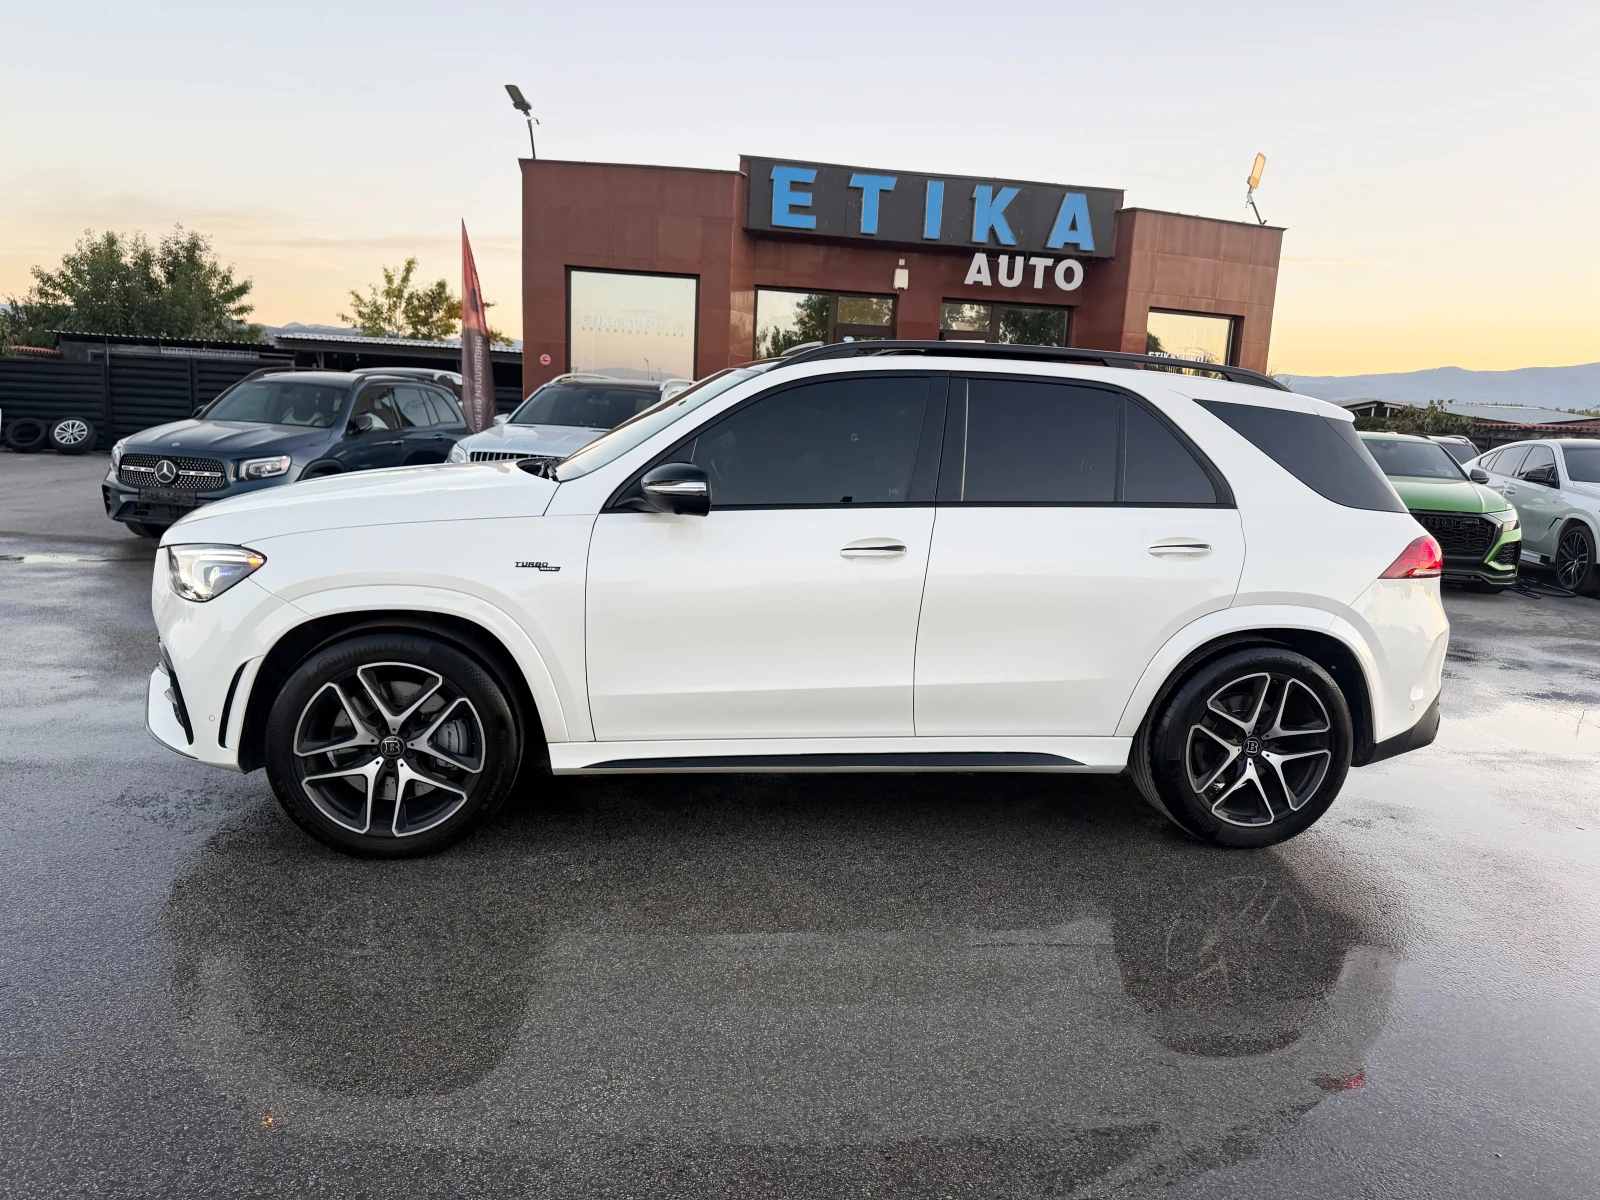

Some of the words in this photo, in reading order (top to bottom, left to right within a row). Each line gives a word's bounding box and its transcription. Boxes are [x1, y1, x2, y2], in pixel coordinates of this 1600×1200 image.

[770, 165, 1095, 251] ETIKA
[963, 252, 1084, 291] AUTO
[581, 315, 619, 328] ETIKA
[623, 317, 659, 329] AUTO
[384, 740, 401, 755] B
[1245, 740, 1259, 754] B
